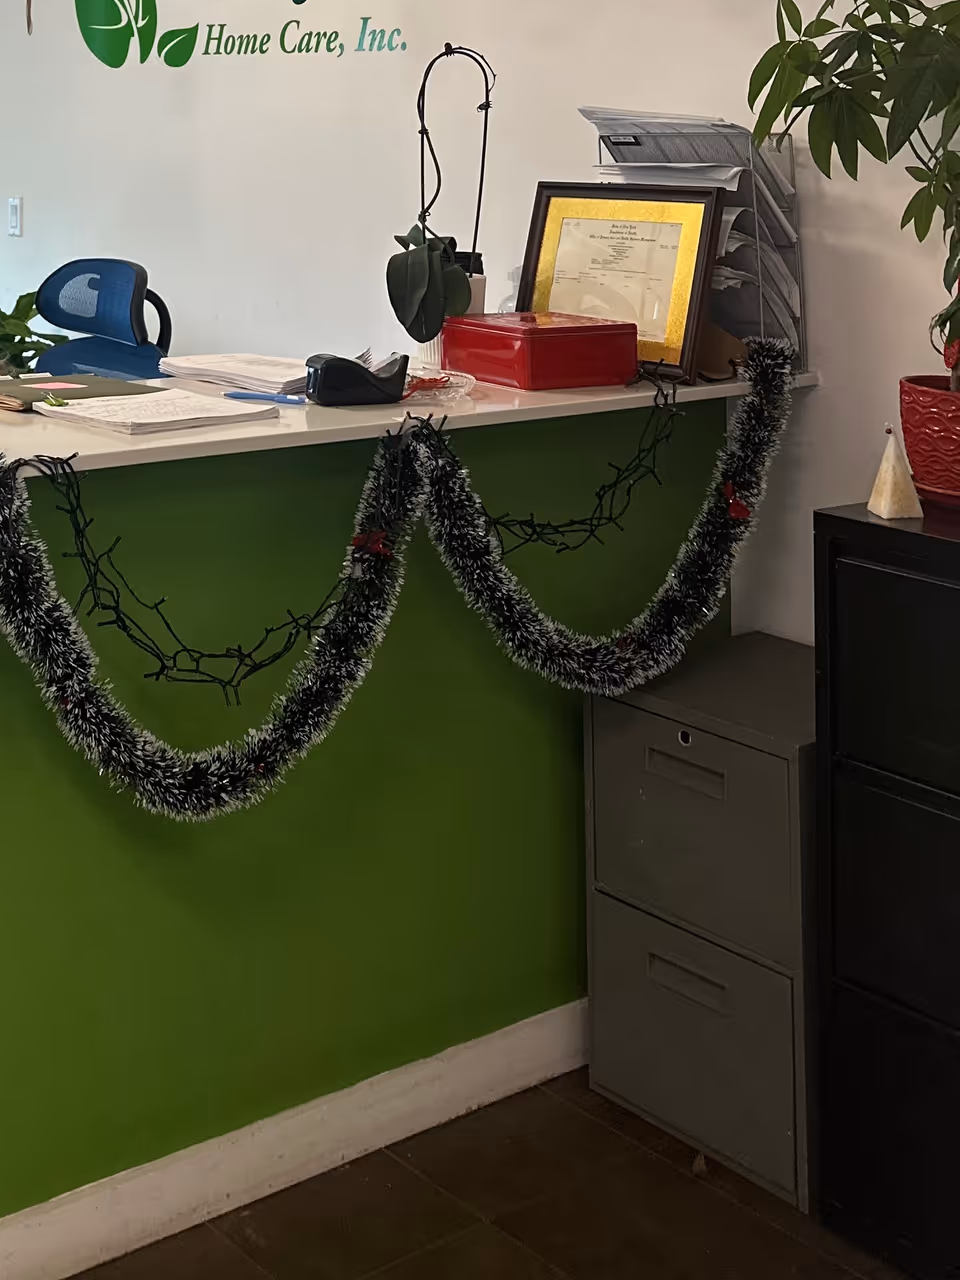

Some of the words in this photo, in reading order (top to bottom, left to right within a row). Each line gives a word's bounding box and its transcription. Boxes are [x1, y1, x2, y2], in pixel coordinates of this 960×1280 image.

[202, 23, 270, 56] Home
[279, 19, 345, 58] Care,
[354, 16, 407, 52] Inc.
